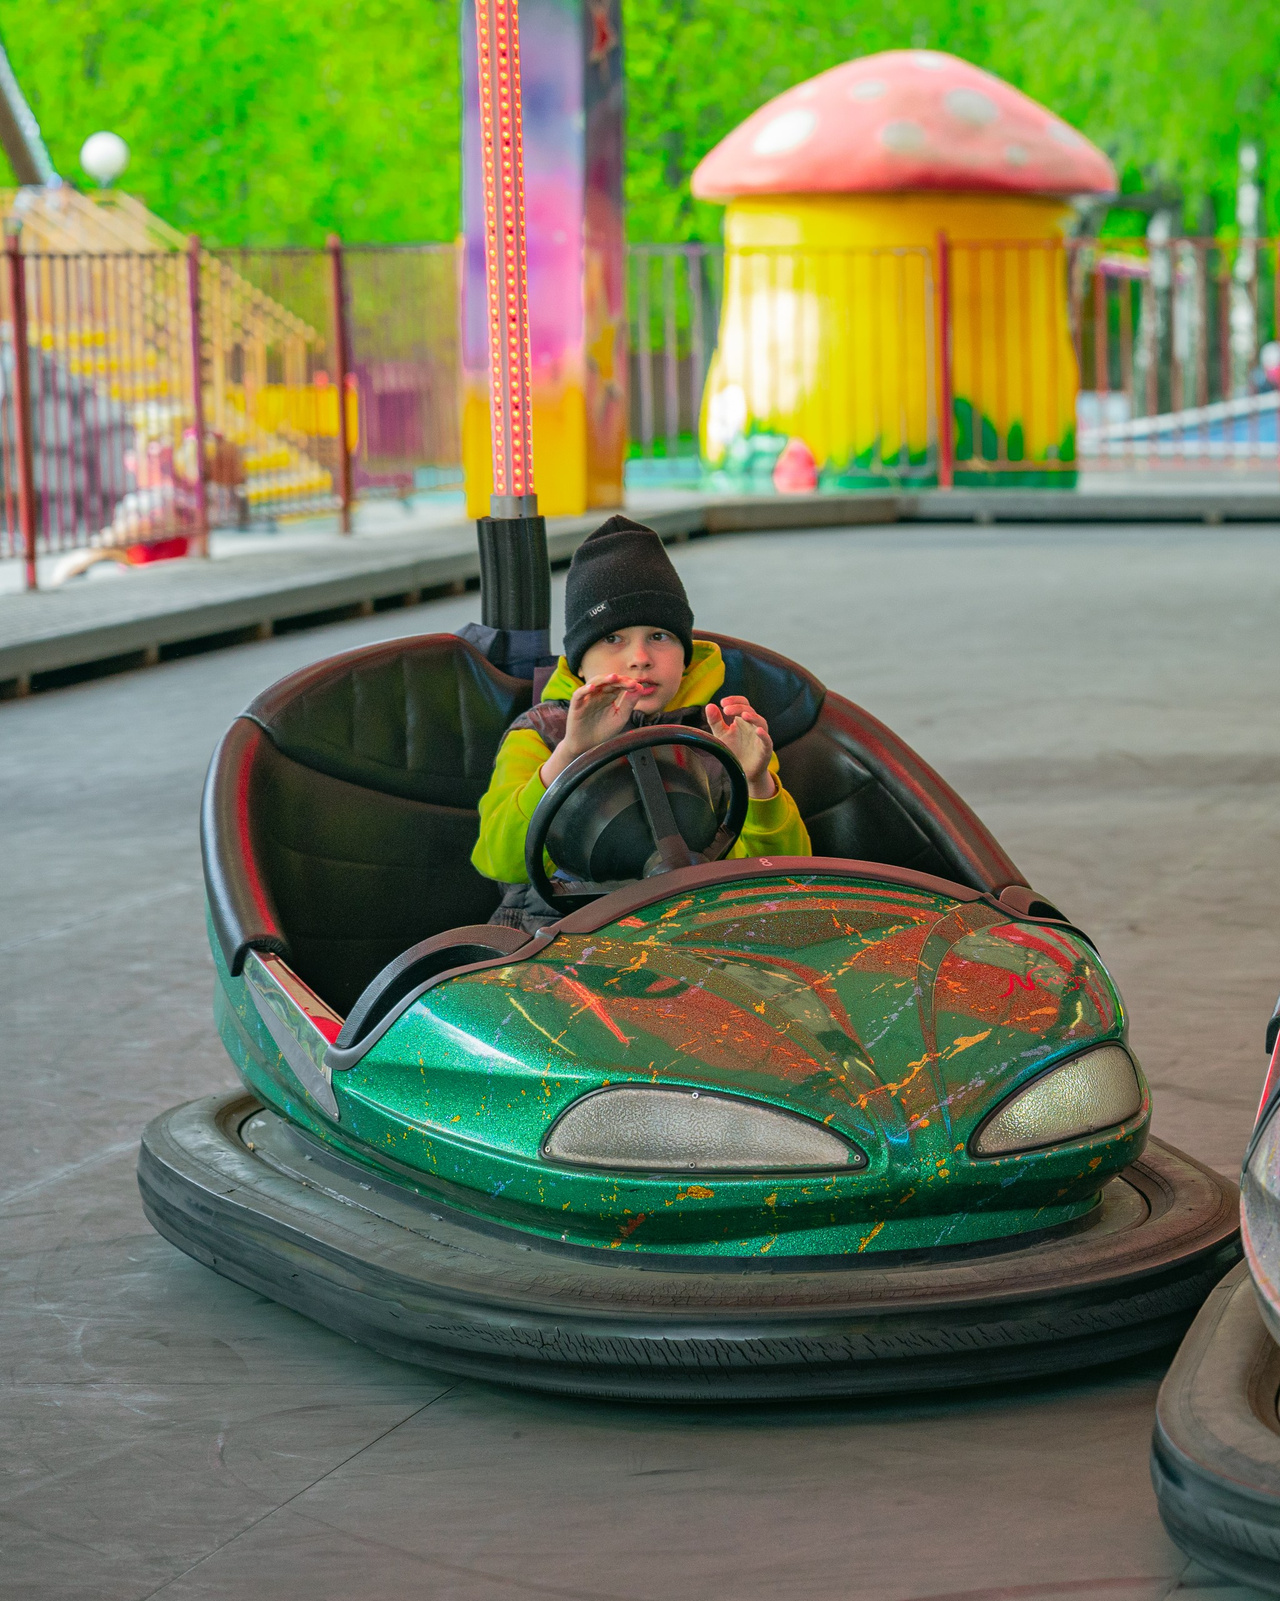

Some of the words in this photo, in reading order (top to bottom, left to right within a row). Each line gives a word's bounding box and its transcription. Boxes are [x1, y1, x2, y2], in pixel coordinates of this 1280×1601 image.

[589, 603, 606, 617] LUCK
[759, 857, 773, 866] 8
[998, 964, 1087, 998] Ninja
